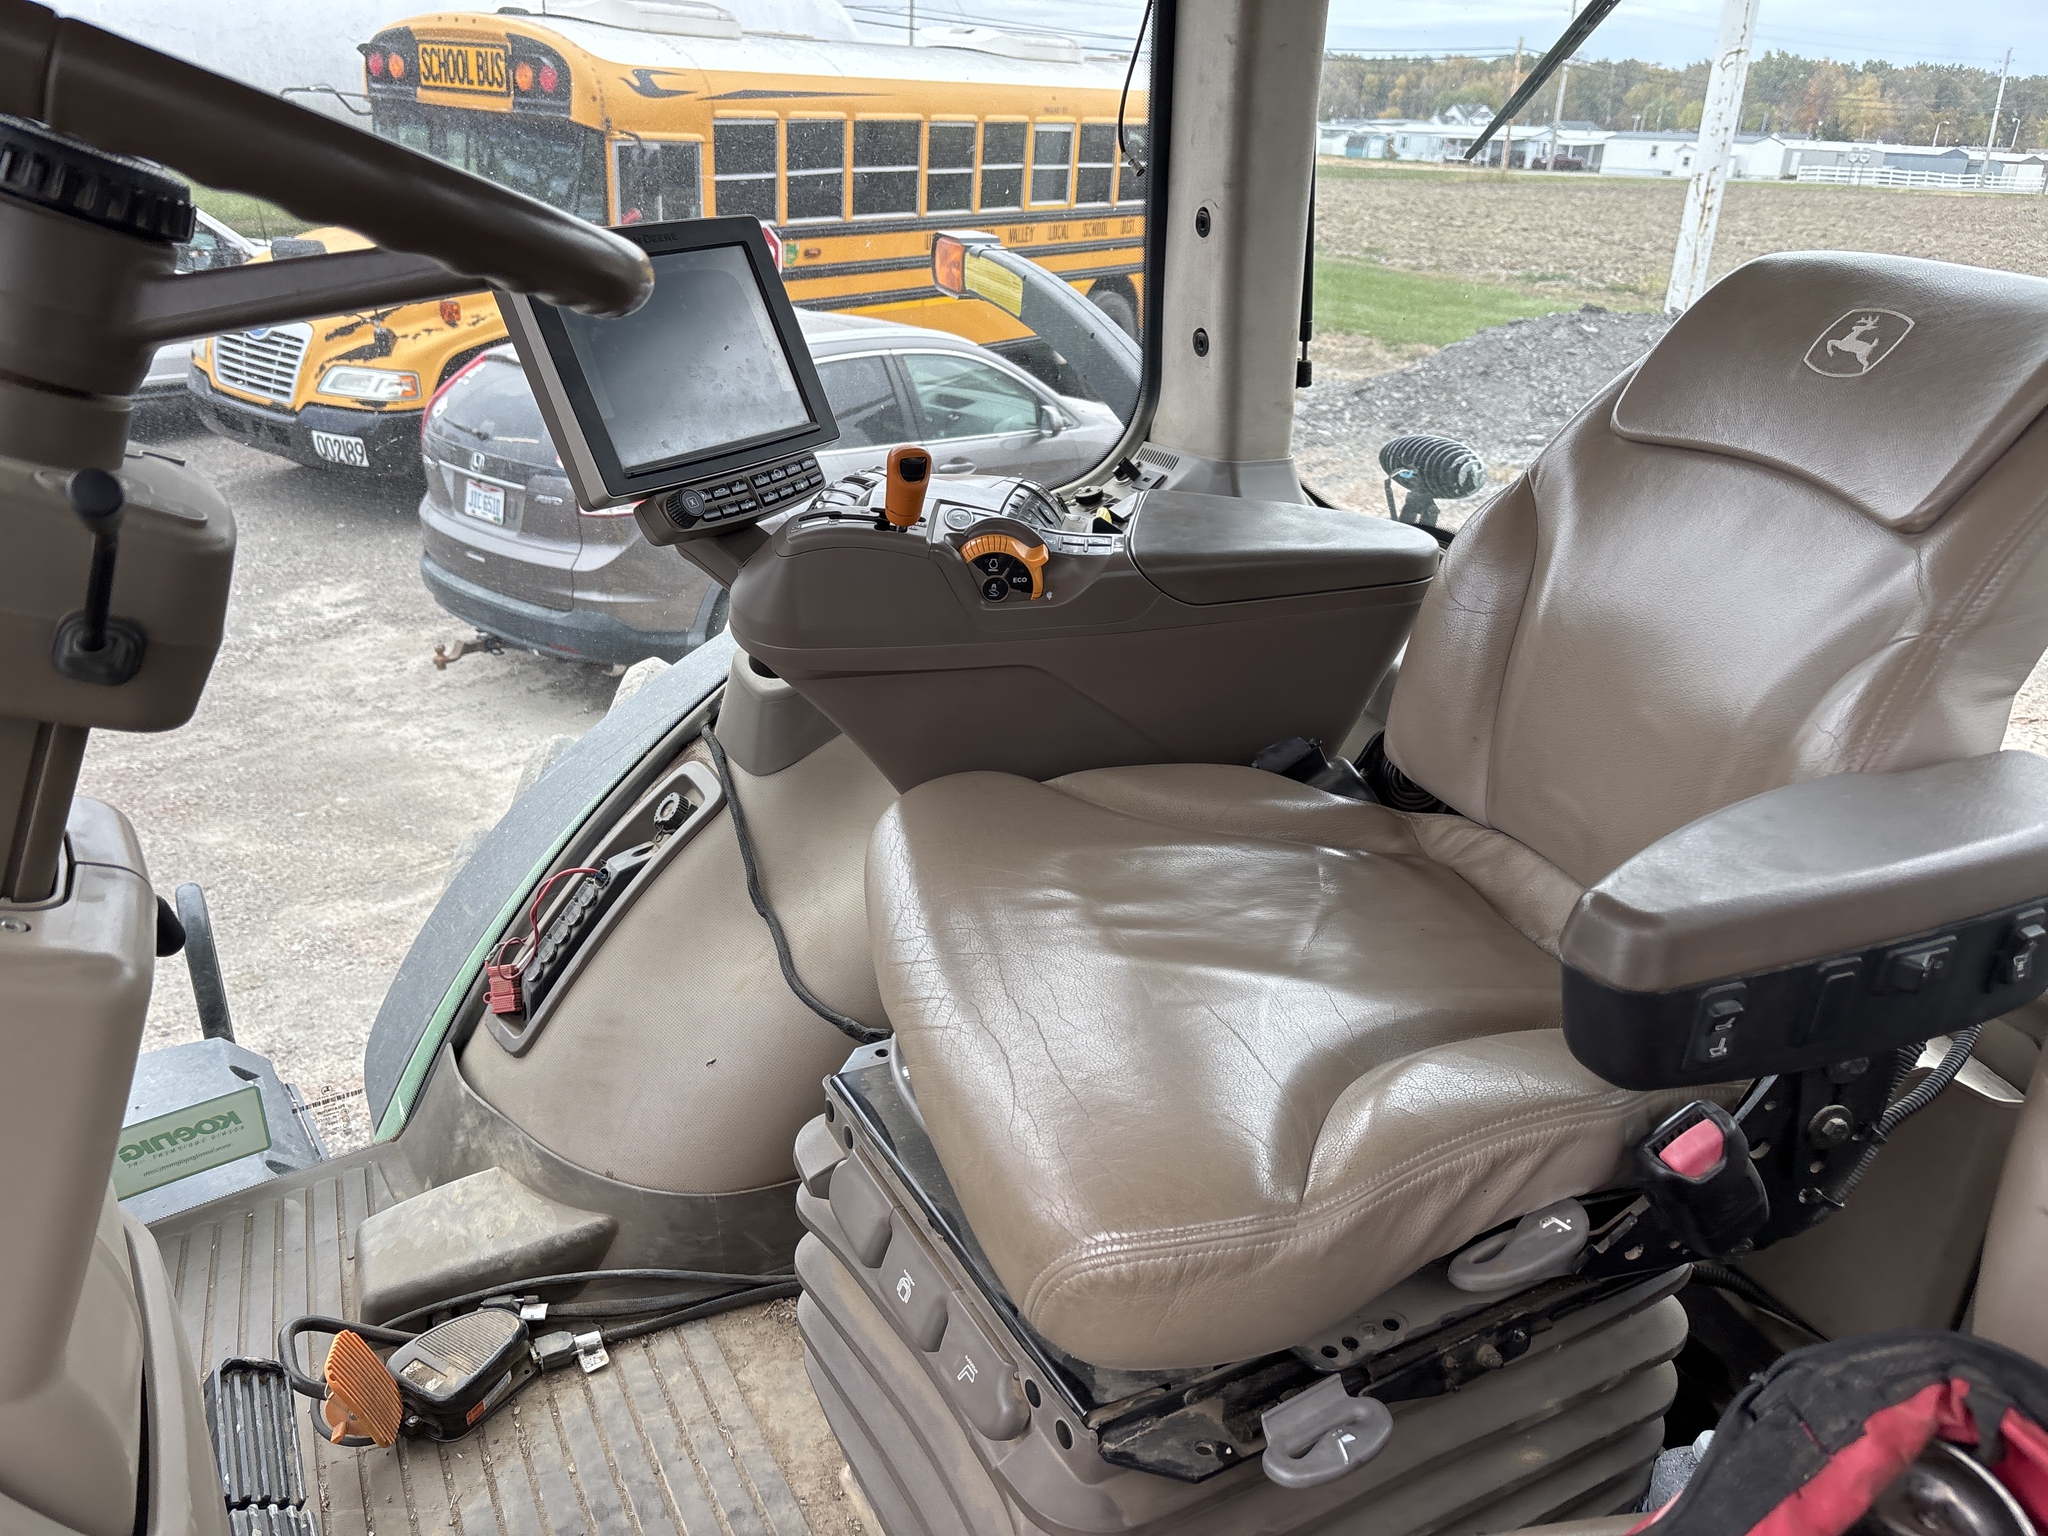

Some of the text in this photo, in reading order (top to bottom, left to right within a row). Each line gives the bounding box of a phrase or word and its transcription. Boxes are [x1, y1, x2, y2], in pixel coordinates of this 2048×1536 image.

[421, 47, 505, 89] SCHOOL BUS
[1008, 225, 1035, 243] VALLEY
[1047, 223, 1069, 241] LOCAL
[1082, 221, 1108, 238] SCHOOL
[316, 434, 365, 465] 002189
[1012, 576, 1028, 584] ECO
